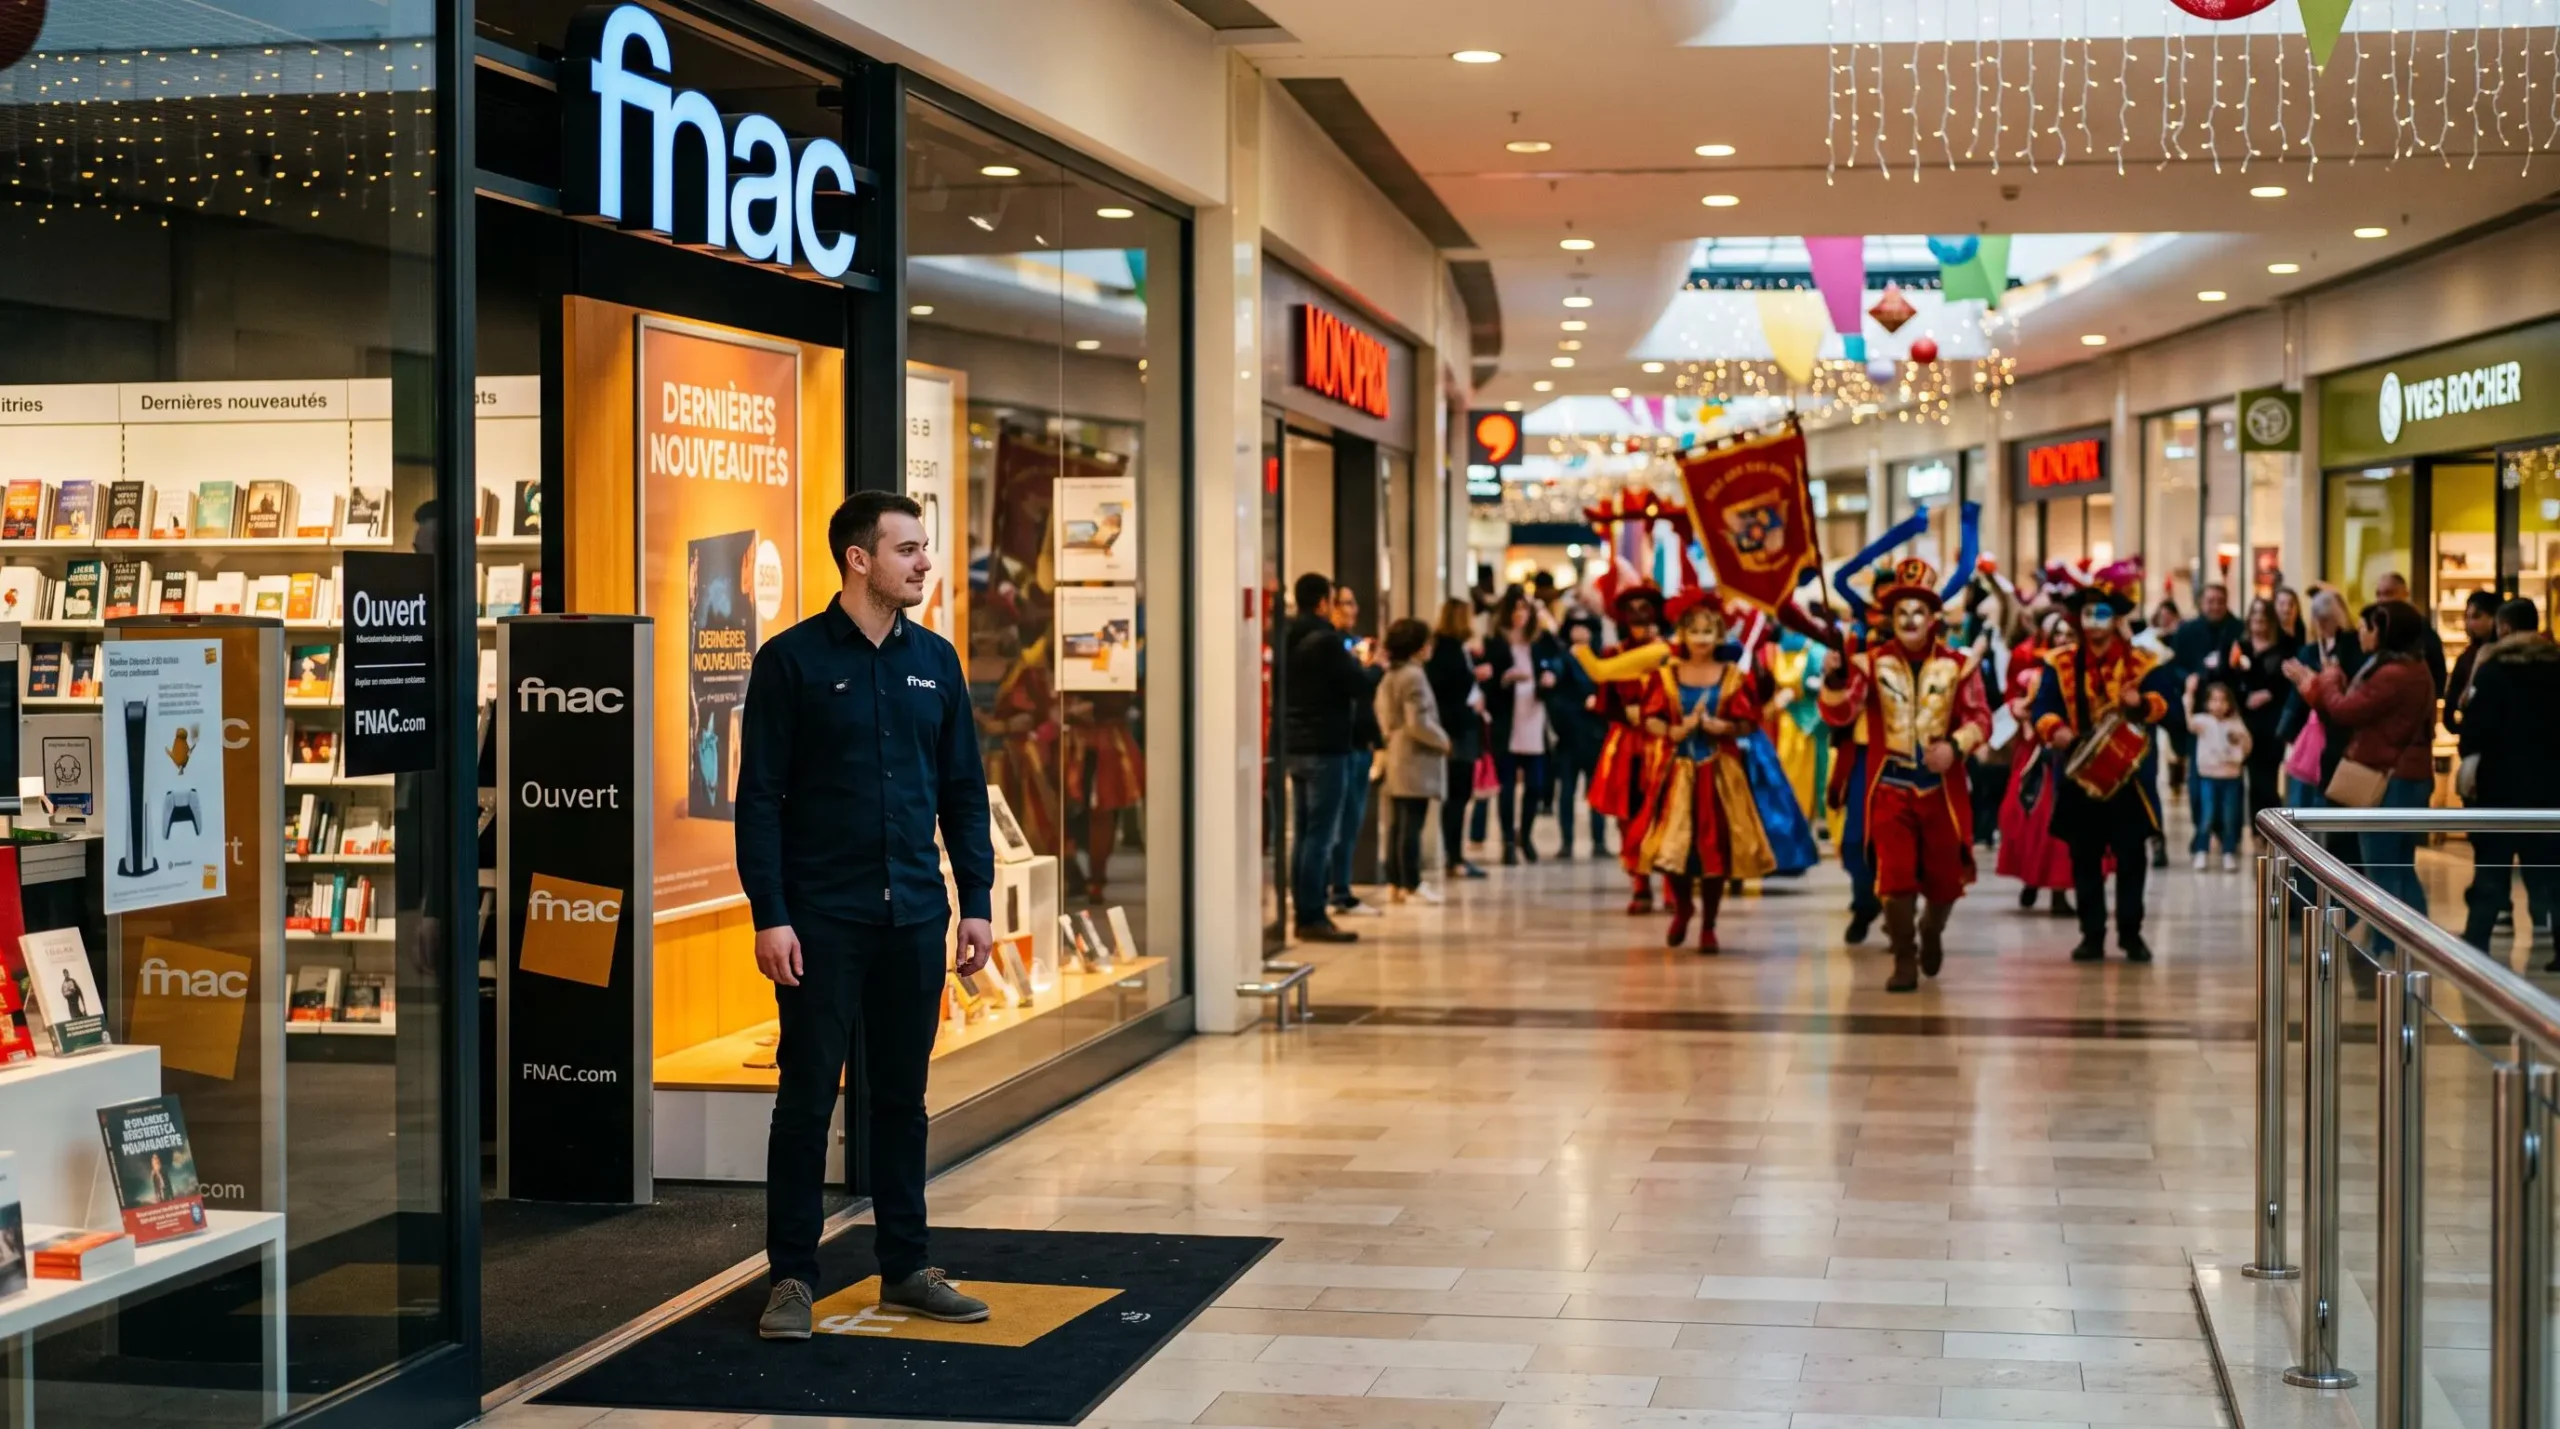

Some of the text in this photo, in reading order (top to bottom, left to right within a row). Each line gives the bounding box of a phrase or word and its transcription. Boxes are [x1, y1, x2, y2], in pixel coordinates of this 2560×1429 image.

[591, 5, 857, 278] fnac
[141, 391, 328, 410] Dernières nouveautés
[662, 380, 777, 437] DERNIÈRES
[2404, 361, 2522, 423] YVES ROCHER
[651, 432, 789, 487] NOUVEAUTÉS
[353, 590, 426, 627] Ouvert
[517, 676, 625, 714] fnac
[906, 675, 936, 689] fnac
[355, 708, 426, 736] FNAC.com
[521, 780, 619, 809] Ouvert
[529, 889, 621, 923] fnac
[140, 957, 249, 998] fnac
[523, 1063, 617, 1083] FNAC.com
